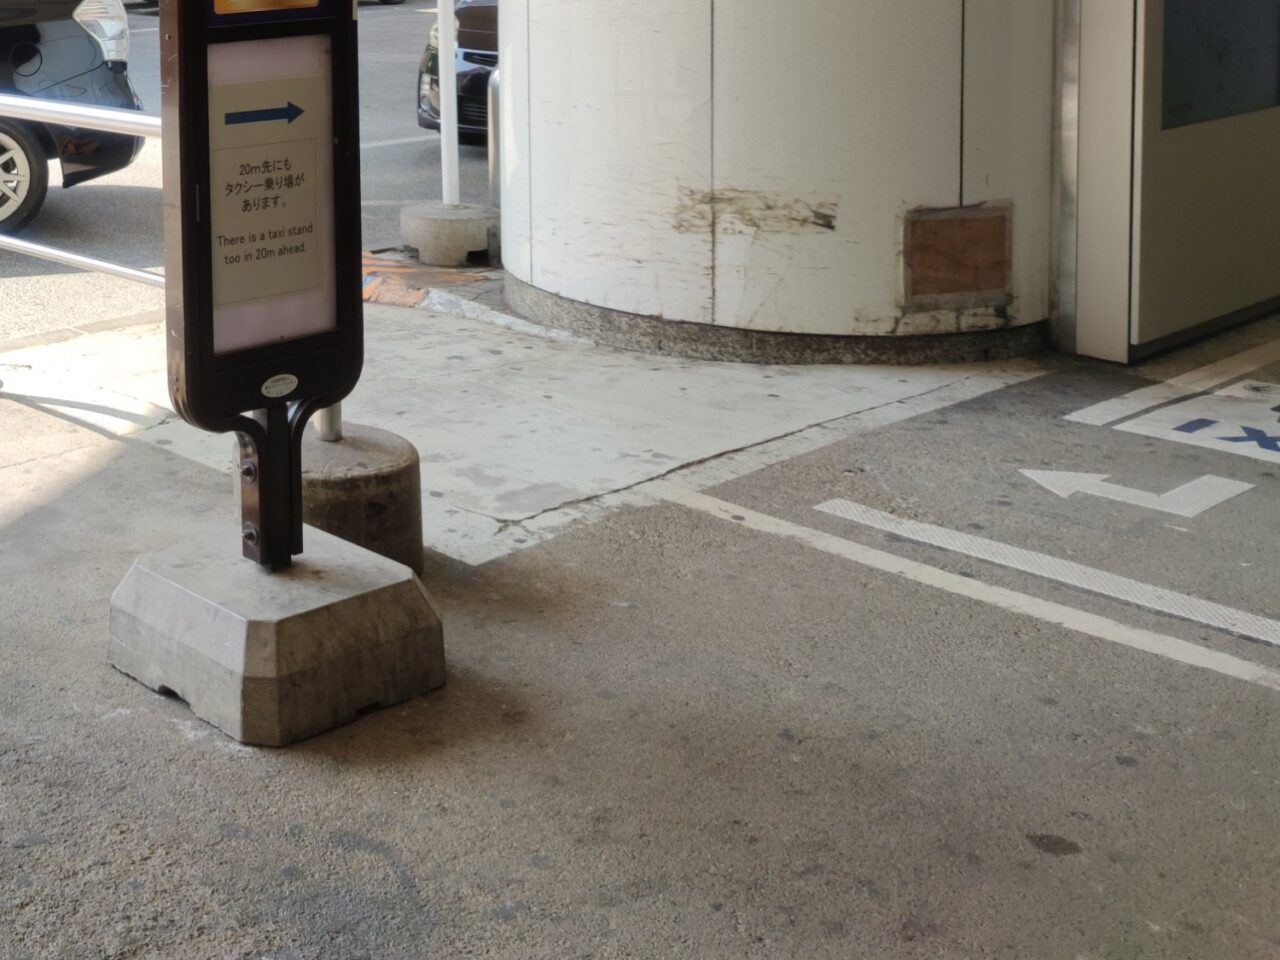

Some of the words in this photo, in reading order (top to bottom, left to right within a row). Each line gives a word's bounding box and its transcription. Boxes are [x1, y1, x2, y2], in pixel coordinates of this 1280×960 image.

[239, 157, 292, 176] 20m先にも
[225, 173, 305, 197] タクシー乗り場が
[241, 194, 287, 213] あります。
[216, 235, 245, 247] There
[248, 231, 257, 243] is
[259, 233, 266, 241] a
[268, 228, 285, 240] taxi
[287, 222, 313, 236] stand
[224, 254, 241, 265] too
[243, 251, 253, 261] in
[255, 246, 275, 260] 20m
